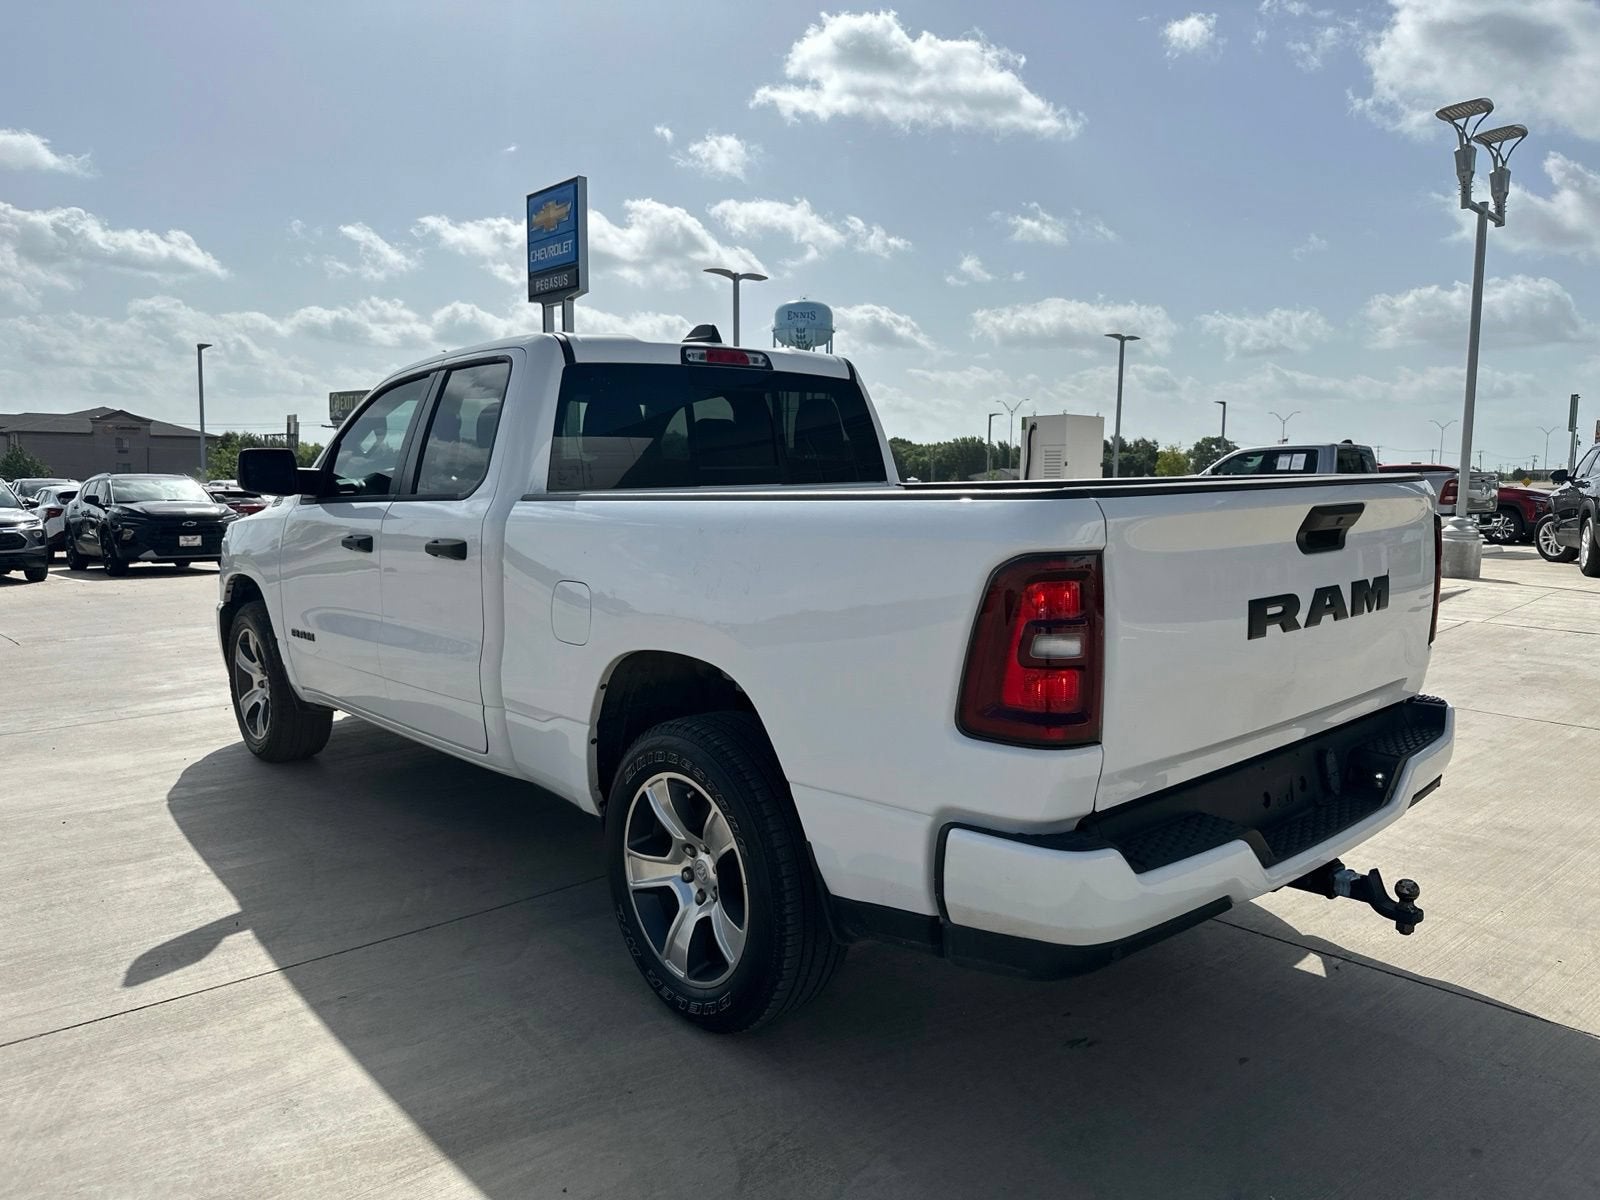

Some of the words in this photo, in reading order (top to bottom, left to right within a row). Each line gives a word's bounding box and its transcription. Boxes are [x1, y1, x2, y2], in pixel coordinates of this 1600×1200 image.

[530, 240, 573, 263] CHEVROLET
[535, 273, 569, 292] PEGASUS
[787, 310, 817, 321] ENNIS
[1247, 573, 1389, 640] RAM
